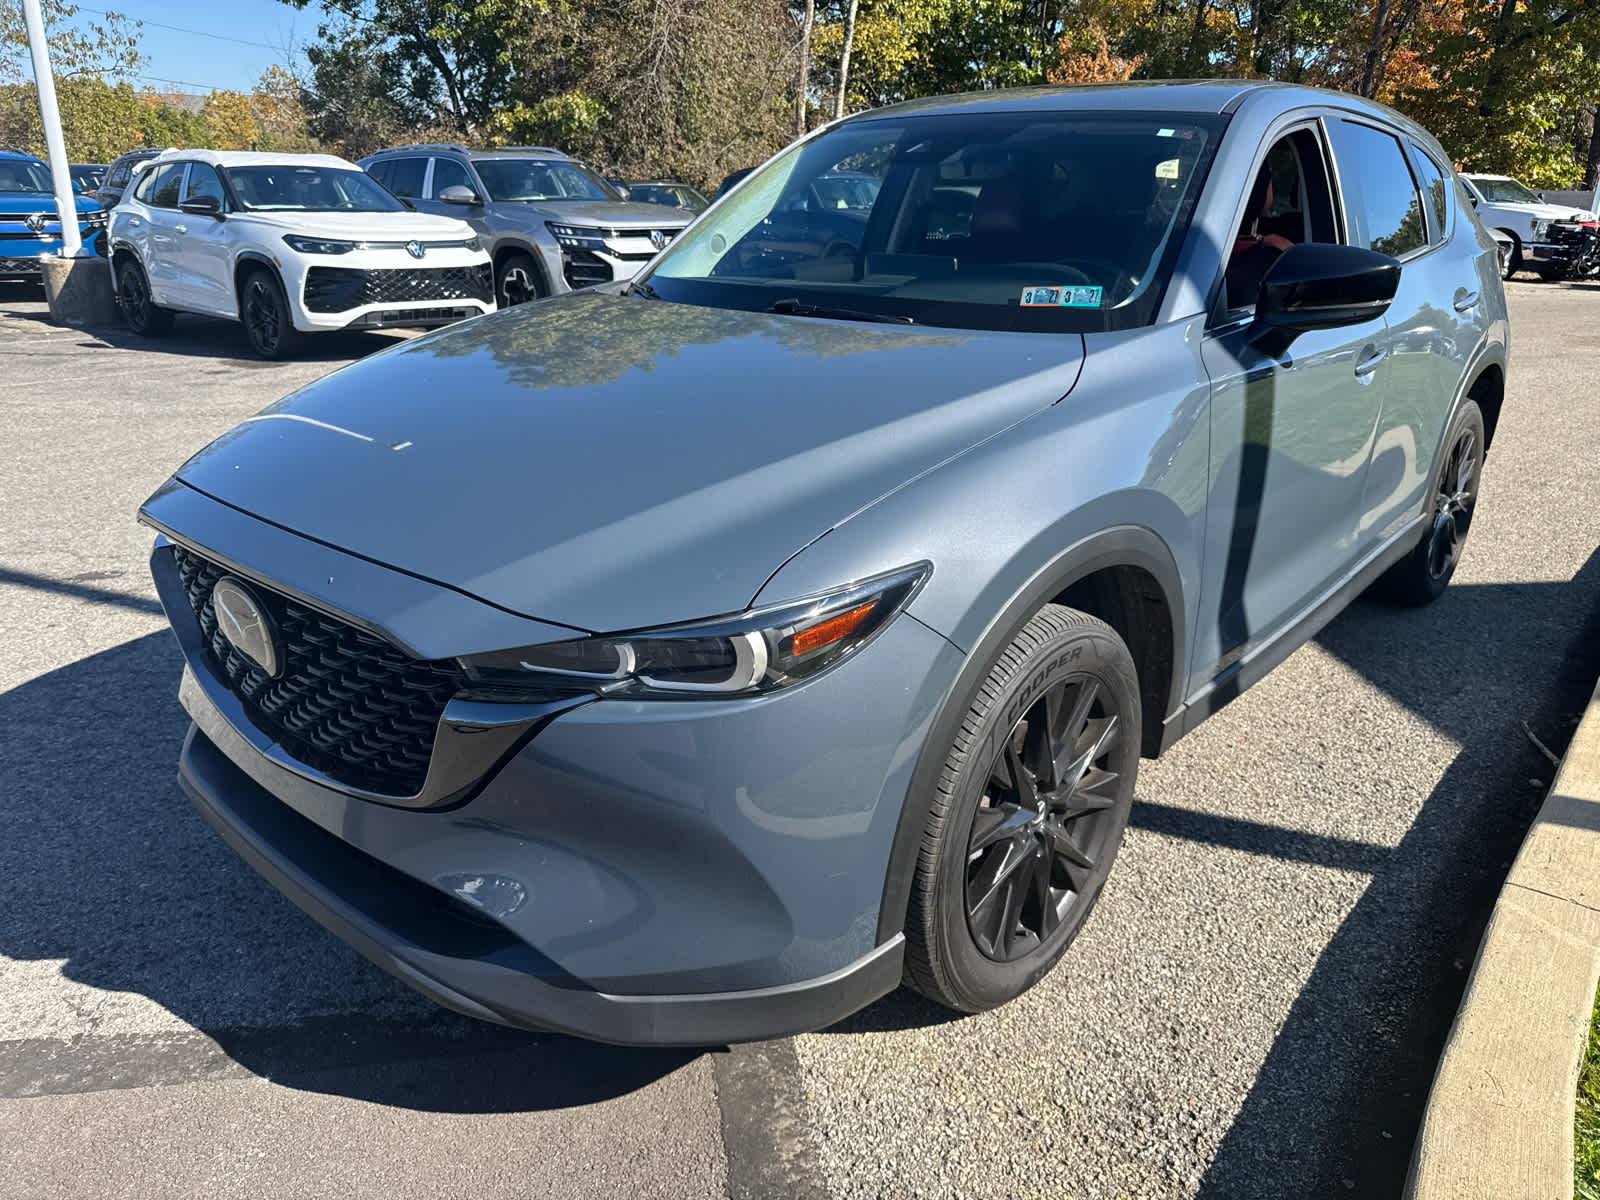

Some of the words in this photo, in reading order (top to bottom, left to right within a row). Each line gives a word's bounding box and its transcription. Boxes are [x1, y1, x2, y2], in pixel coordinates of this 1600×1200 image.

[1025, 292, 1032, 304] 3
[1064, 291, 1072, 303] 3
[1007, 646, 1083, 726] COOPER
